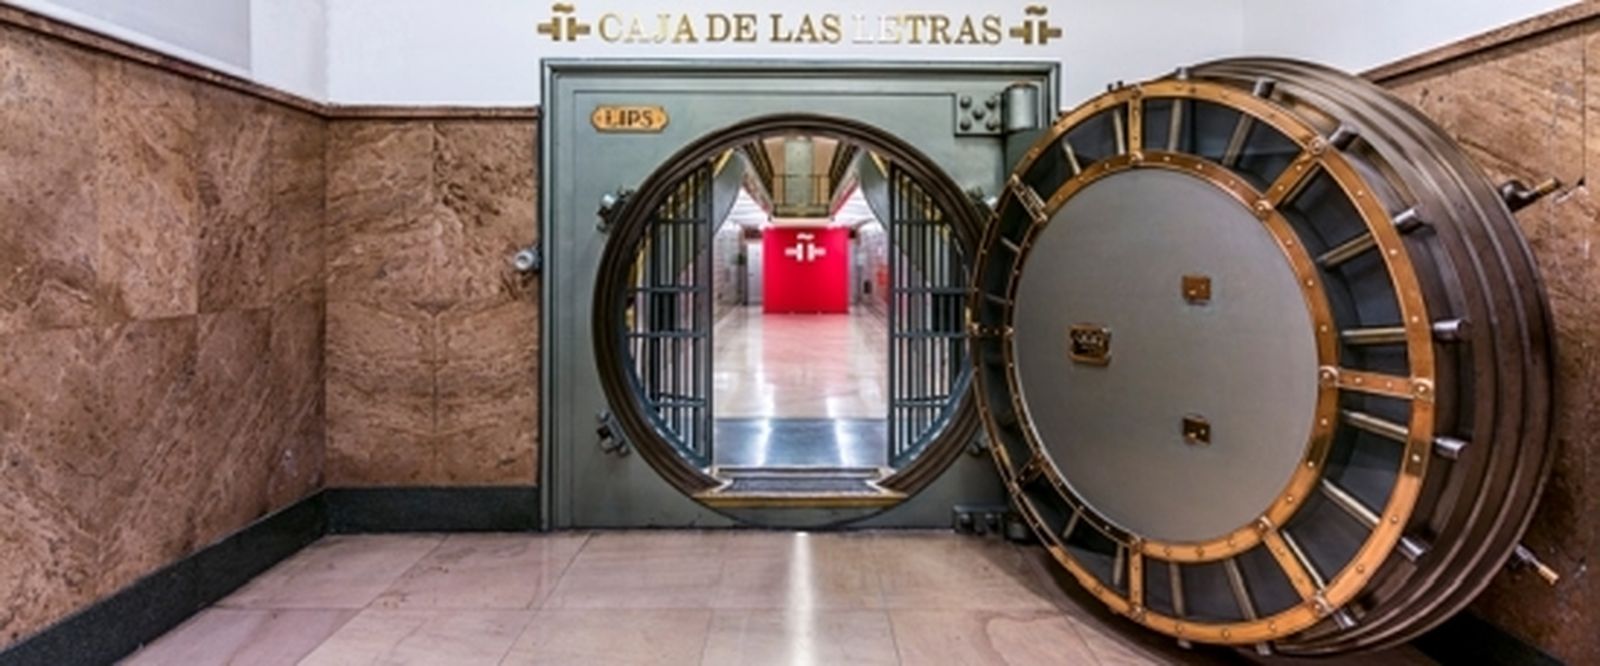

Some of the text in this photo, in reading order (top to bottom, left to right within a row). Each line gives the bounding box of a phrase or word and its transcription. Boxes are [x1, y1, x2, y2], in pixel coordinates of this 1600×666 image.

[598, 13, 1002, 44] CAJA DE LAS LETRAS
[604, 109, 654, 127] LIPS
